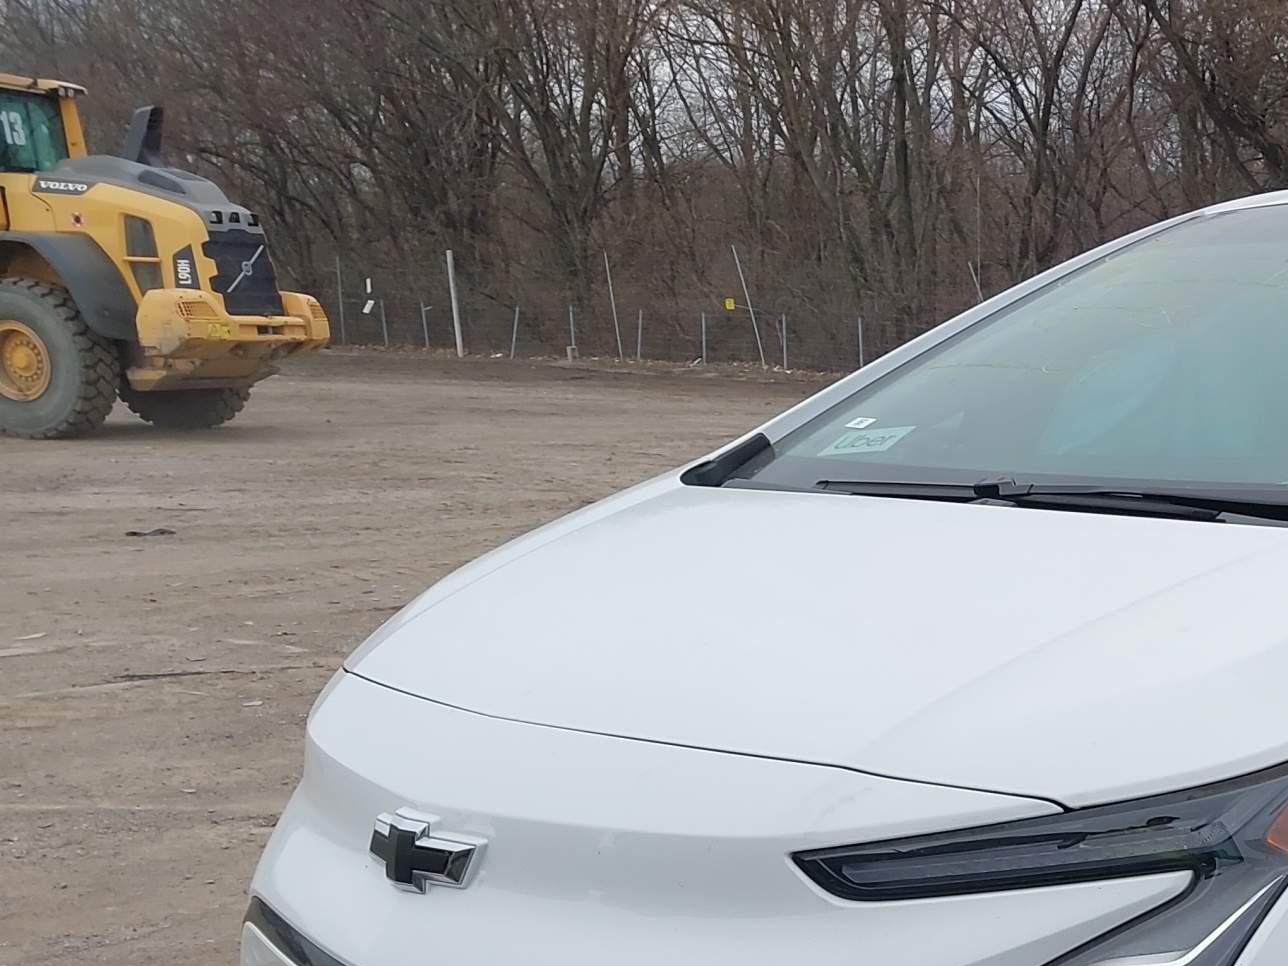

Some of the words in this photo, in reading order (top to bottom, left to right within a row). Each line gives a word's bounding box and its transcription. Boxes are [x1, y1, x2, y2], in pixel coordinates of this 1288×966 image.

[0, 111, 26, 146] 13
[39, 180, 88, 192] VOLVO
[177, 259, 193, 285] L90H
[832, 433, 898, 450] Uber
